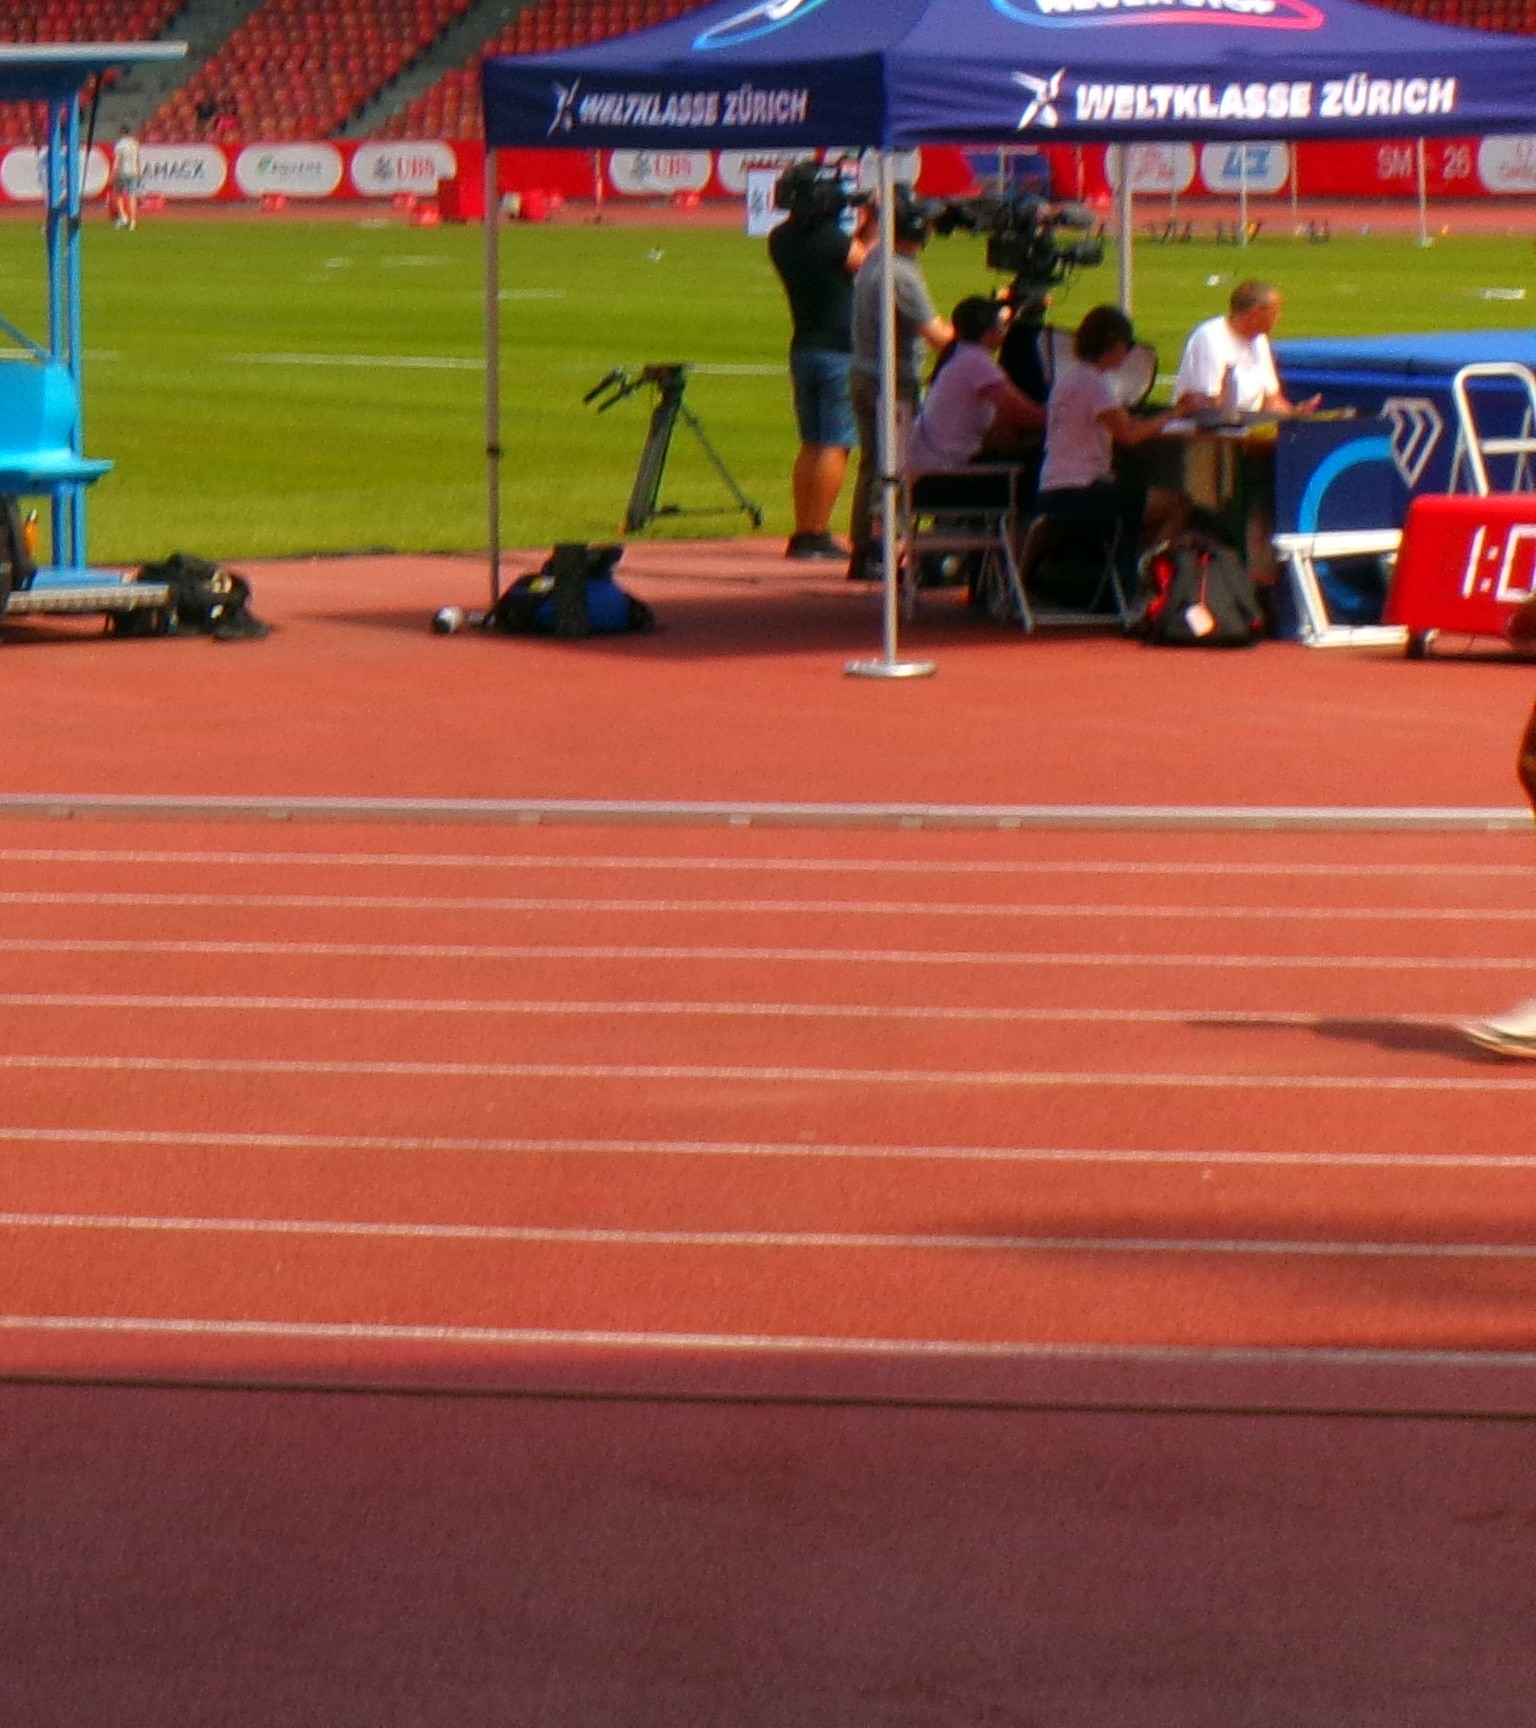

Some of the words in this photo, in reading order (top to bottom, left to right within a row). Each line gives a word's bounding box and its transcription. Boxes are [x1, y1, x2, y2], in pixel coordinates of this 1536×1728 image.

[578, 92, 721, 127] WELTKLASSE
[723, 83, 808, 127] ZÜRICH
[1076, 82, 1313, 121] WELTKLASSE
[1319, 72, 1457, 118] ZÜRICH
[395, 156, 436, 180] UBS
